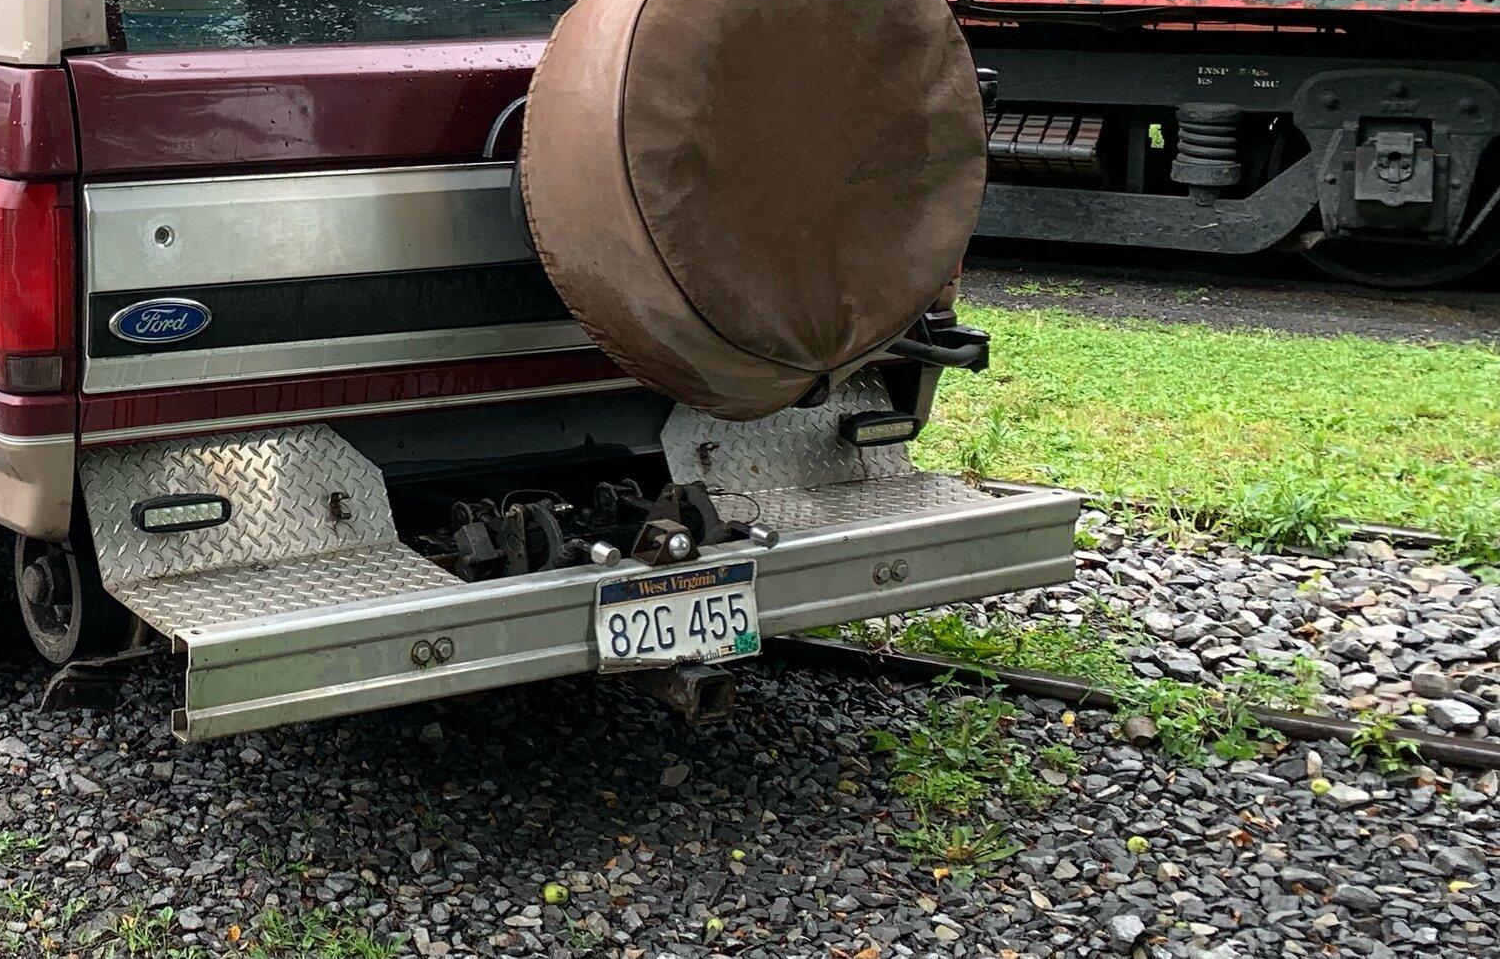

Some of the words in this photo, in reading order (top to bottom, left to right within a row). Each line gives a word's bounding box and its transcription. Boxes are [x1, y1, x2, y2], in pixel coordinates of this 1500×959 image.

[1197, 66, 1229, 75] INSP
[135, 308, 188, 333] Ford
[638, 580, 667, 595] West
[671, 572, 716, 590] Virginia
[608, 605, 676, 658] 82G
[688, 593, 749, 643] 455
